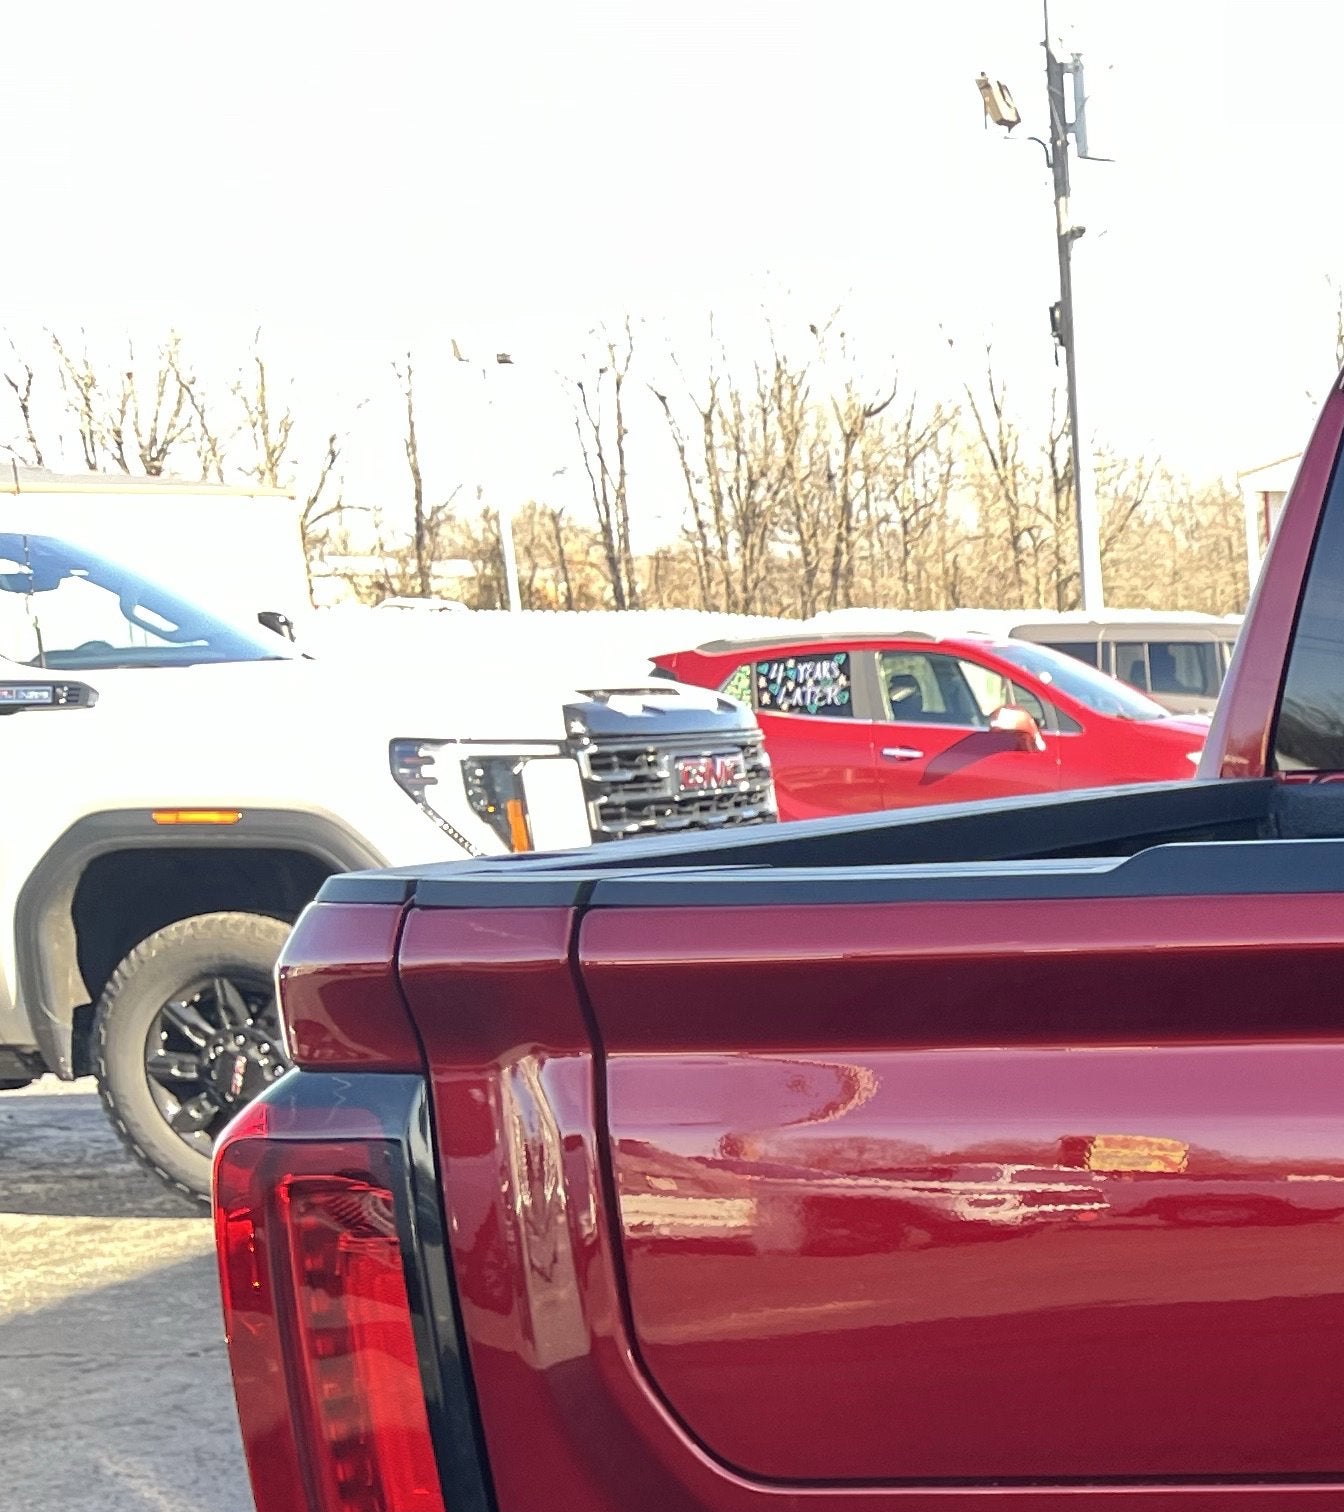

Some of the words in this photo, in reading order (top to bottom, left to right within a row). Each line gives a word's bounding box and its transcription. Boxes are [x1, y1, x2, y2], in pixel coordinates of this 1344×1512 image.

[768, 662, 785, 685] 4
[796, 660, 841, 684] YEARS
[776, 684, 842, 706] LATER
